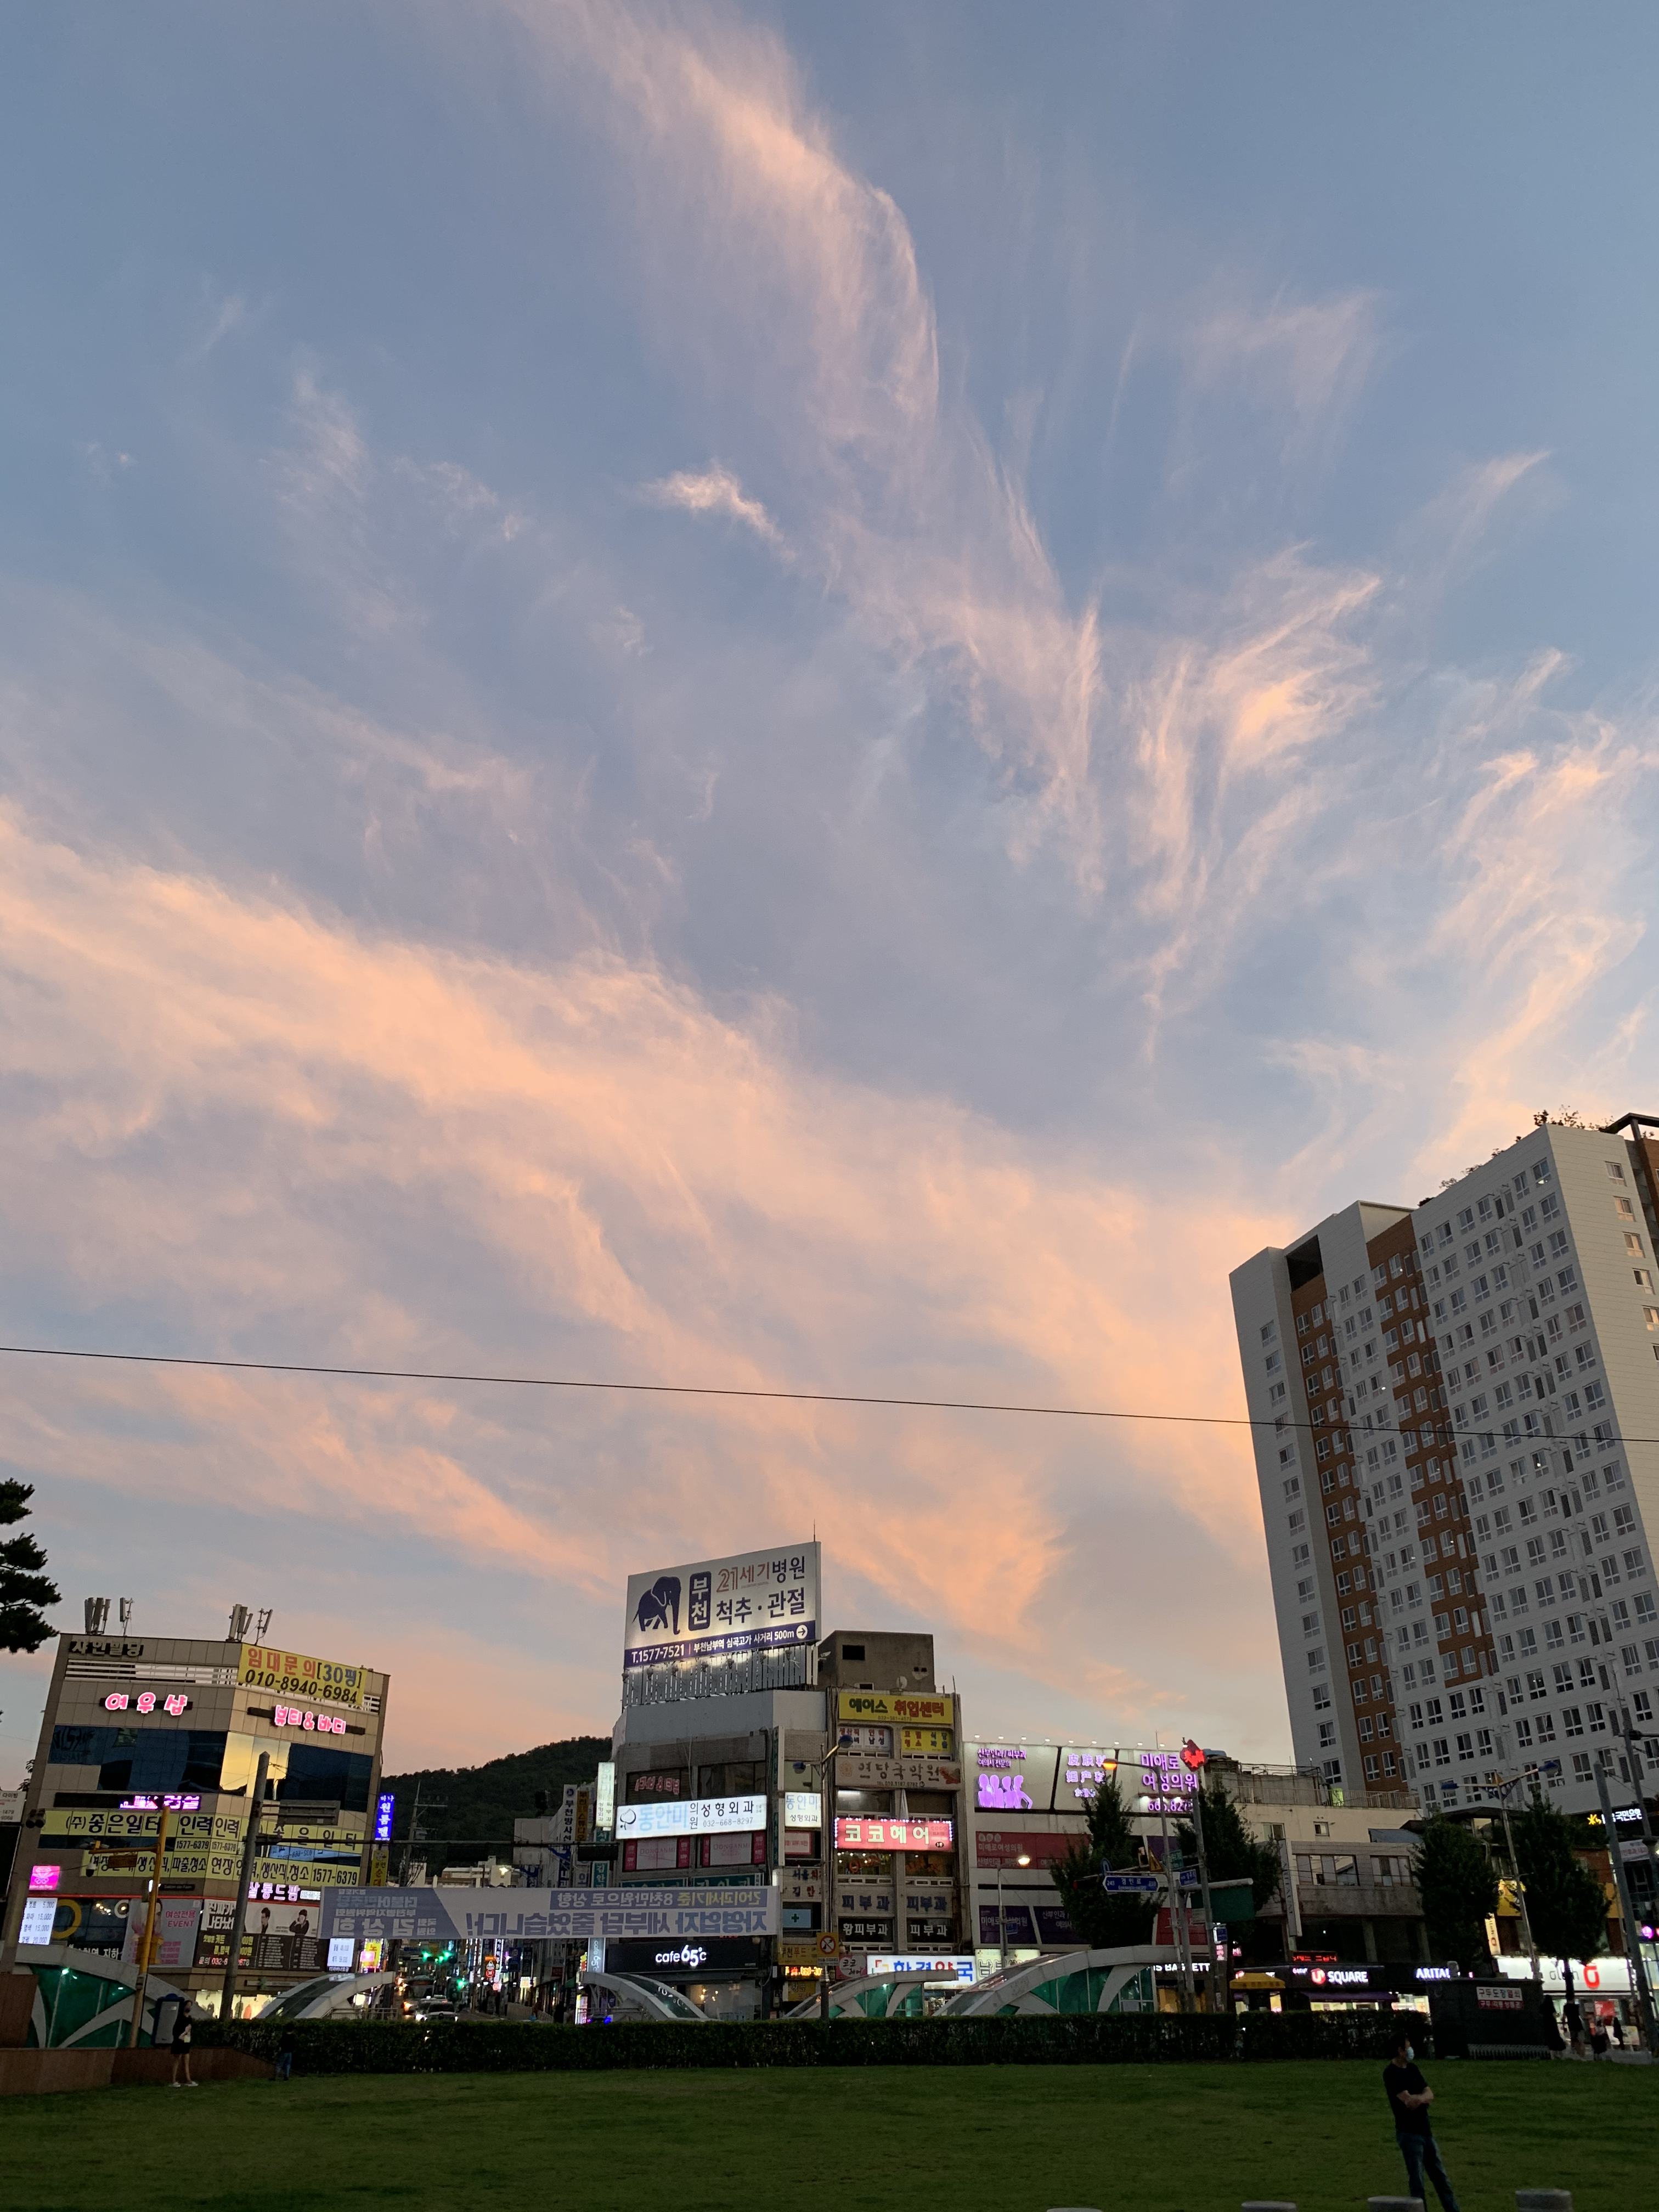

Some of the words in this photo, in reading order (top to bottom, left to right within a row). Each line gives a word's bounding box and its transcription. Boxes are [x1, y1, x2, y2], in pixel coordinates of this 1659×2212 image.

[691, 1577, 709, 1625] 부천
[716, 1597, 752, 1625] 척추
[768, 1587, 805, 1618] 관절
[631, 1644, 684, 1663] T.1577-7521
[693, 1638, 724, 1652] 부천남부역
[726, 1637, 752, 1647] 심곡고가
[753, 1632, 773, 1643] 사거리
[774, 1629, 794, 1640] 500m
[245, 1669, 357, 1705] 010-8940-6984
[849, 1698, 888, 1713] 에이스
[894, 1700, 944, 1717] 취업센터
[275, 1705, 346, 1734] 뷰티&바디
[978, 1758, 994, 1767] 여의사
[995, 1759, 1011, 1768] 전문의
[1141, 1753, 1180, 1771] 미애로
[786, 1795, 818, 1810] 동안미
[639, 1804, 687, 1831] 동안미
[701, 1801, 754, 1818] 성형외과
[703, 1817, 753, 1827] 032-668-8297
[180, 1815, 213, 1836] 인력
[215, 1818, 240, 1838] 인력
[844, 1824, 929, 1844] 코코헤어
[176, 1839, 209, 1849] 1577-6379
[211, 1841, 236, 1852] 1577-6379
[313, 1868, 358, 1886] 1577-6379
[842, 1894, 890, 1910] 피부과
[907, 1895, 947, 1911] 피부과
[165, 1910, 196, 1918] 여성전용
[843, 1922, 888, 1936] 황피부과
[910, 1925, 947, 1937] 피부과
[843, 1959, 857, 1967] 코코
[1327, 1971, 1369, 1985] SQUARE
